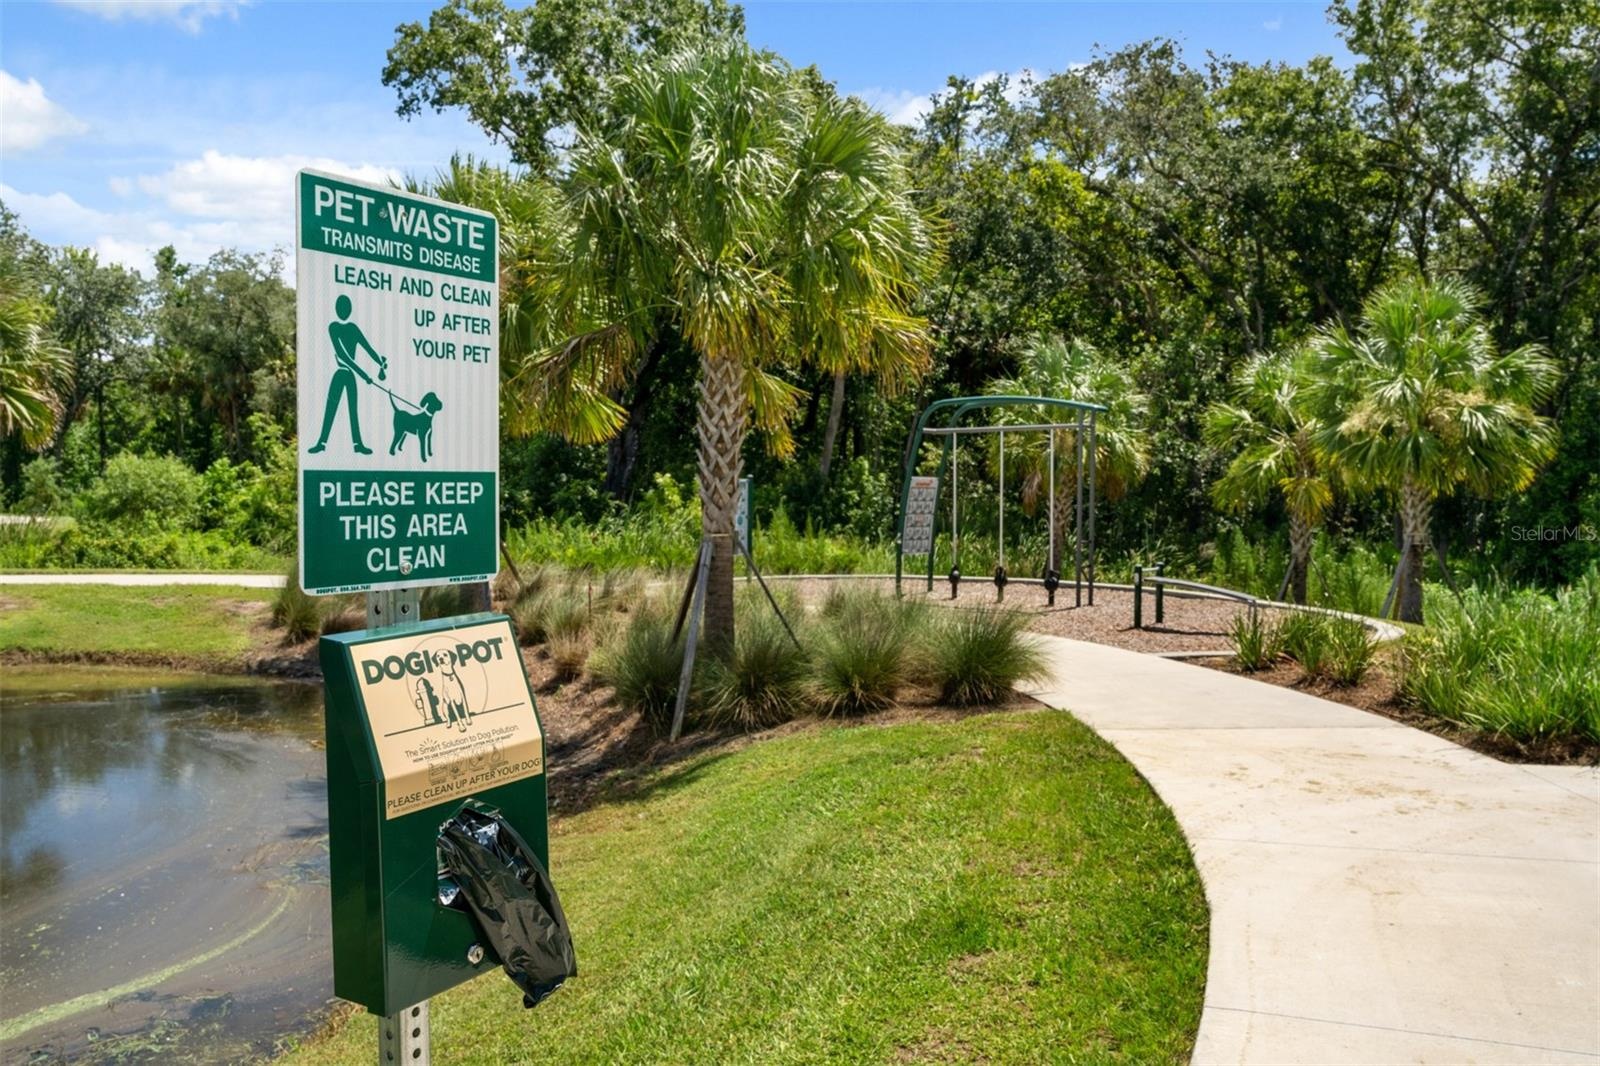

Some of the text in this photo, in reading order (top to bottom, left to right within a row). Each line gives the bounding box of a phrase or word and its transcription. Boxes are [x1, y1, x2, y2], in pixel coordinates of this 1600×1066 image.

[314, 184, 486, 251] PET WASTE
[321, 227, 481, 274] TRANSMITS DISEASE
[334, 264, 491, 307] LEASH AND CLEAN
[414, 309, 491, 335] UP AFTER
[412, 338, 491, 363] YOUR PET
[319, 481, 484, 507] PLEASE KEEP
[339, 513, 468, 541] THIS AREA
[366, 544, 446, 573] CLEAN
[404, 748, 418, 758] The
[419, 742, 440, 754] Smart
[441, 736, 468, 748] Solution
[476, 730, 491, 740] Dog
[387, 791, 421, 808] PLEASE
[423, 782, 454, 797] CLEAN
[455, 777, 469, 788] UP
[468, 769, 496, 784] AFTER
[497, 762, 522, 776] YOUR
